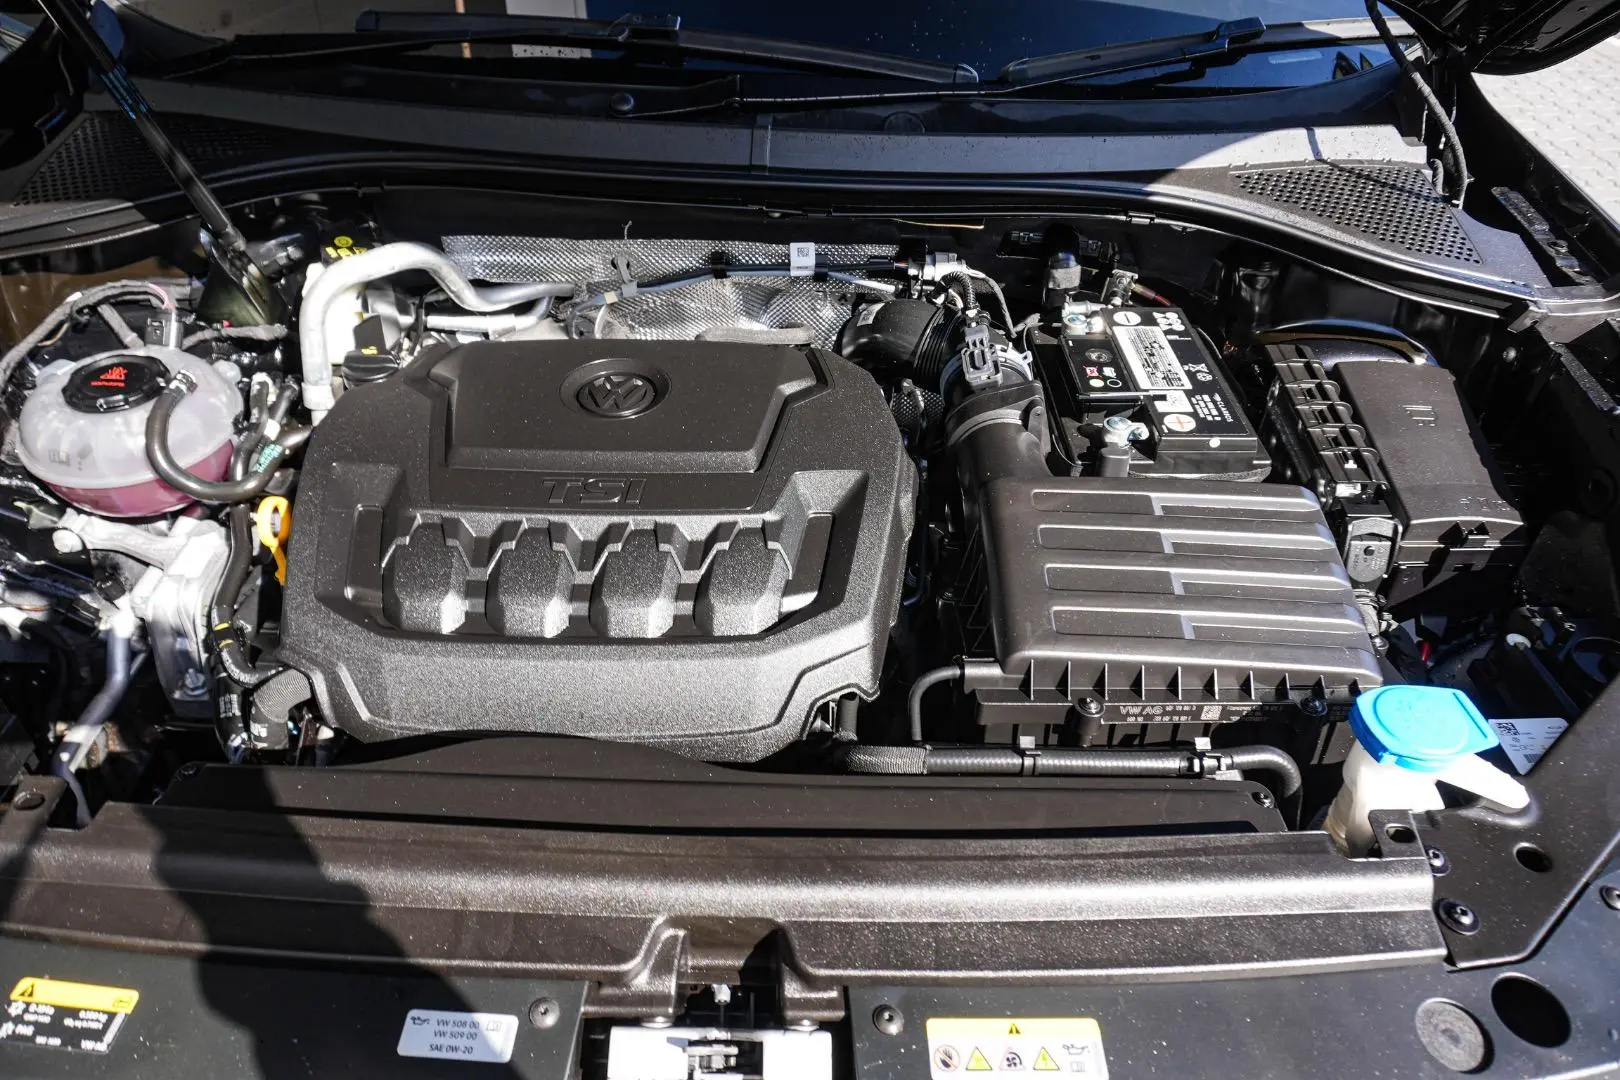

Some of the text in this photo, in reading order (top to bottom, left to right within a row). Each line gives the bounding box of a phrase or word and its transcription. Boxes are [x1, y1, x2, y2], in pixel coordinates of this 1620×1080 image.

[1217, 401, 1233, 422] CLARIOS
[542, 478, 646, 503] TSI
[1120, 705, 1142, 715] VW
[1143, 705, 1163, 715] AG
[436, 1019, 480, 1030] VW 508 00
[433, 1029, 478, 1041] VW 509 00
[429, 1043, 474, 1055] SAE 0W-20
